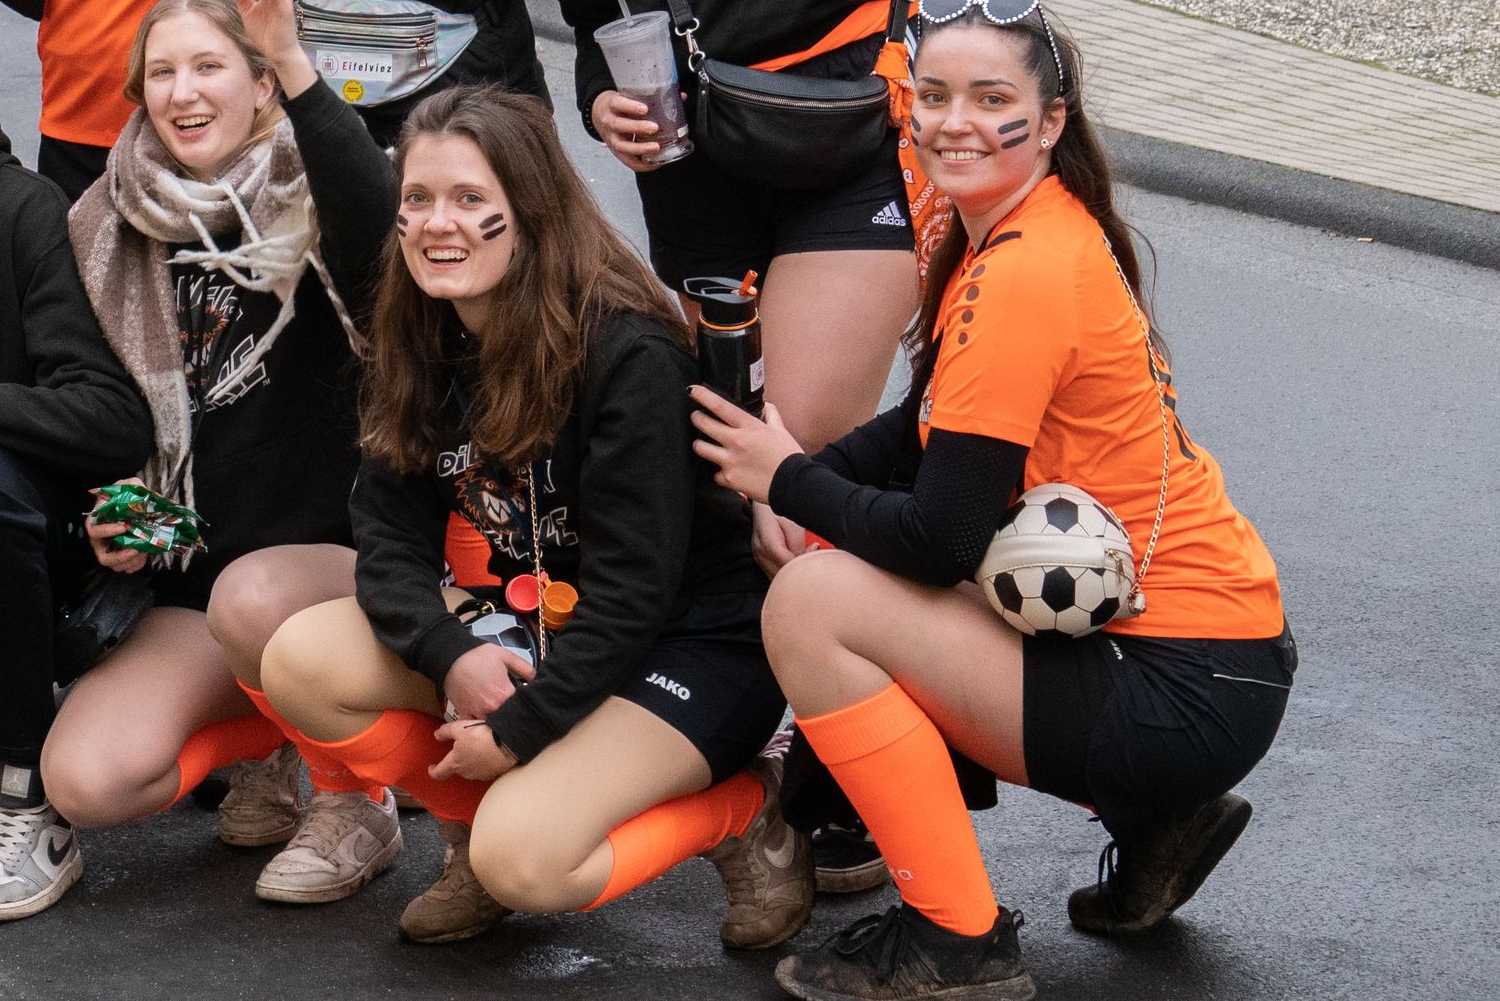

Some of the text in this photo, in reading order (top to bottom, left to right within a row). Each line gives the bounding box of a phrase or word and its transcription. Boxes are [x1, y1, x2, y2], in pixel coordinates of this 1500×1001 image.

[342, 61, 392, 73] Eifelviez
[871, 215, 907, 227] adidas
[645, 672, 691, 701] JAKO
